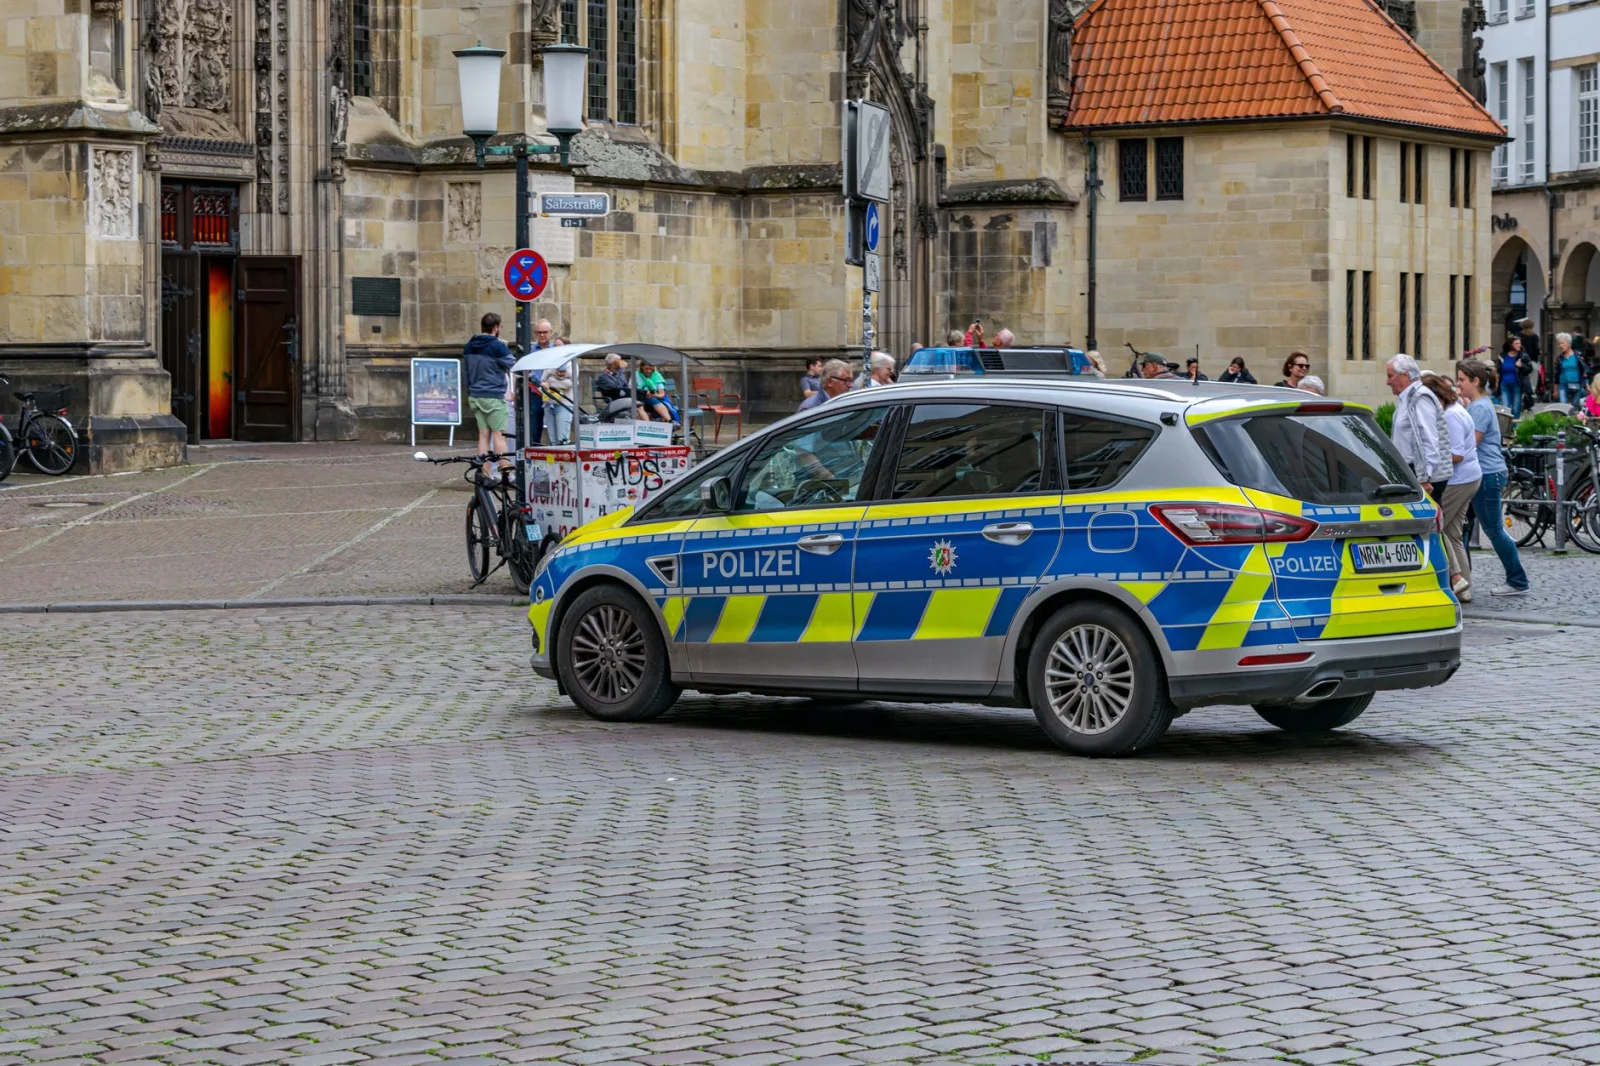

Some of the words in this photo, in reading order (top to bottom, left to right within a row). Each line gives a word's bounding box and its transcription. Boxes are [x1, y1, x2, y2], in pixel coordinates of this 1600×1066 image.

[545, 198, 603, 210] Salzstraße
[1359, 543, 1380, 565] NRW
[1385, 543, 1418, 563] 4-6099
[703, 550, 800, 578] POLIZEI
[1274, 556, 1338, 573] POLIZEI
